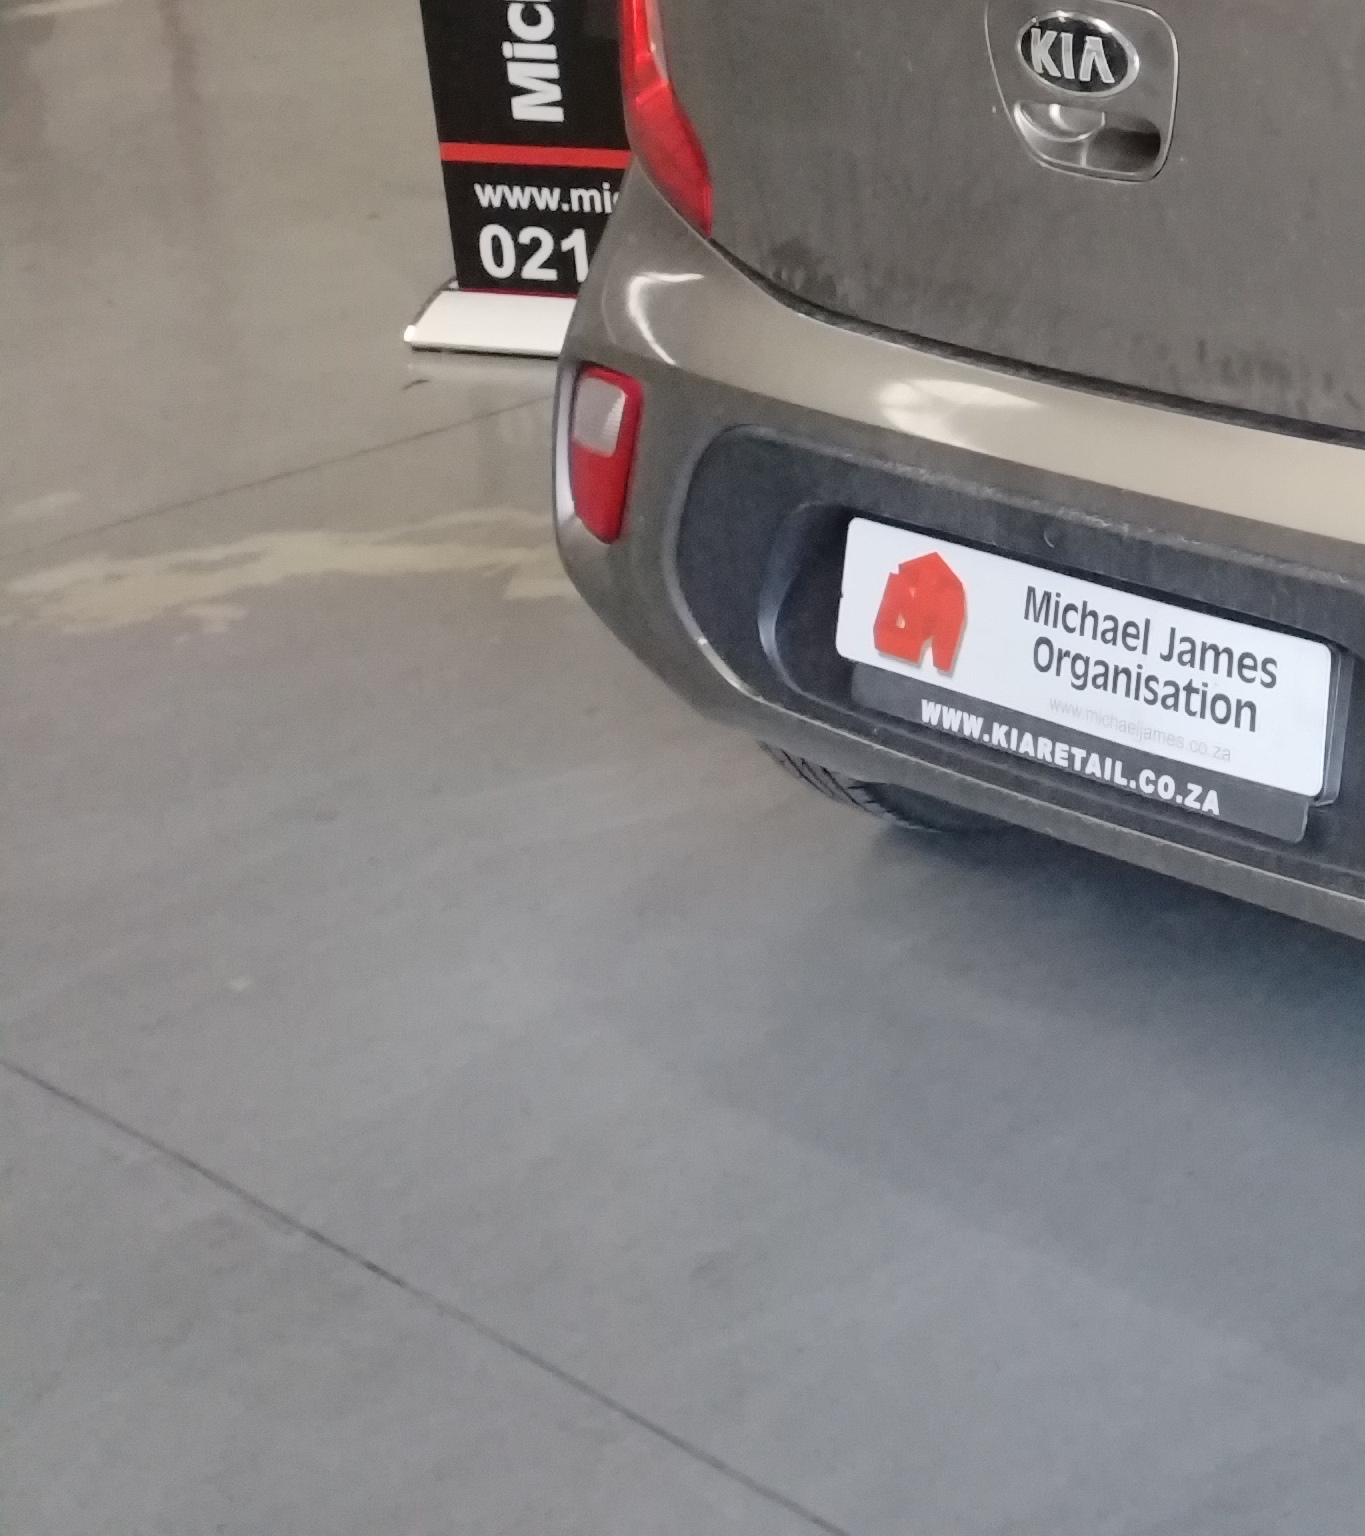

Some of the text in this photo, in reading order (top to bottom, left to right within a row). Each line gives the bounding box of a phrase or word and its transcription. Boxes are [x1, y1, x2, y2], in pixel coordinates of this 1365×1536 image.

[1031, 27, 1116, 84] KIA
[479, 223, 590, 283] 021
[1023, 585, 1279, 689] Michael James
[1033, 636, 1257, 733] Organisation
[920, 698, 1221, 816] WWW.KIARETAIL.CO.ZA
